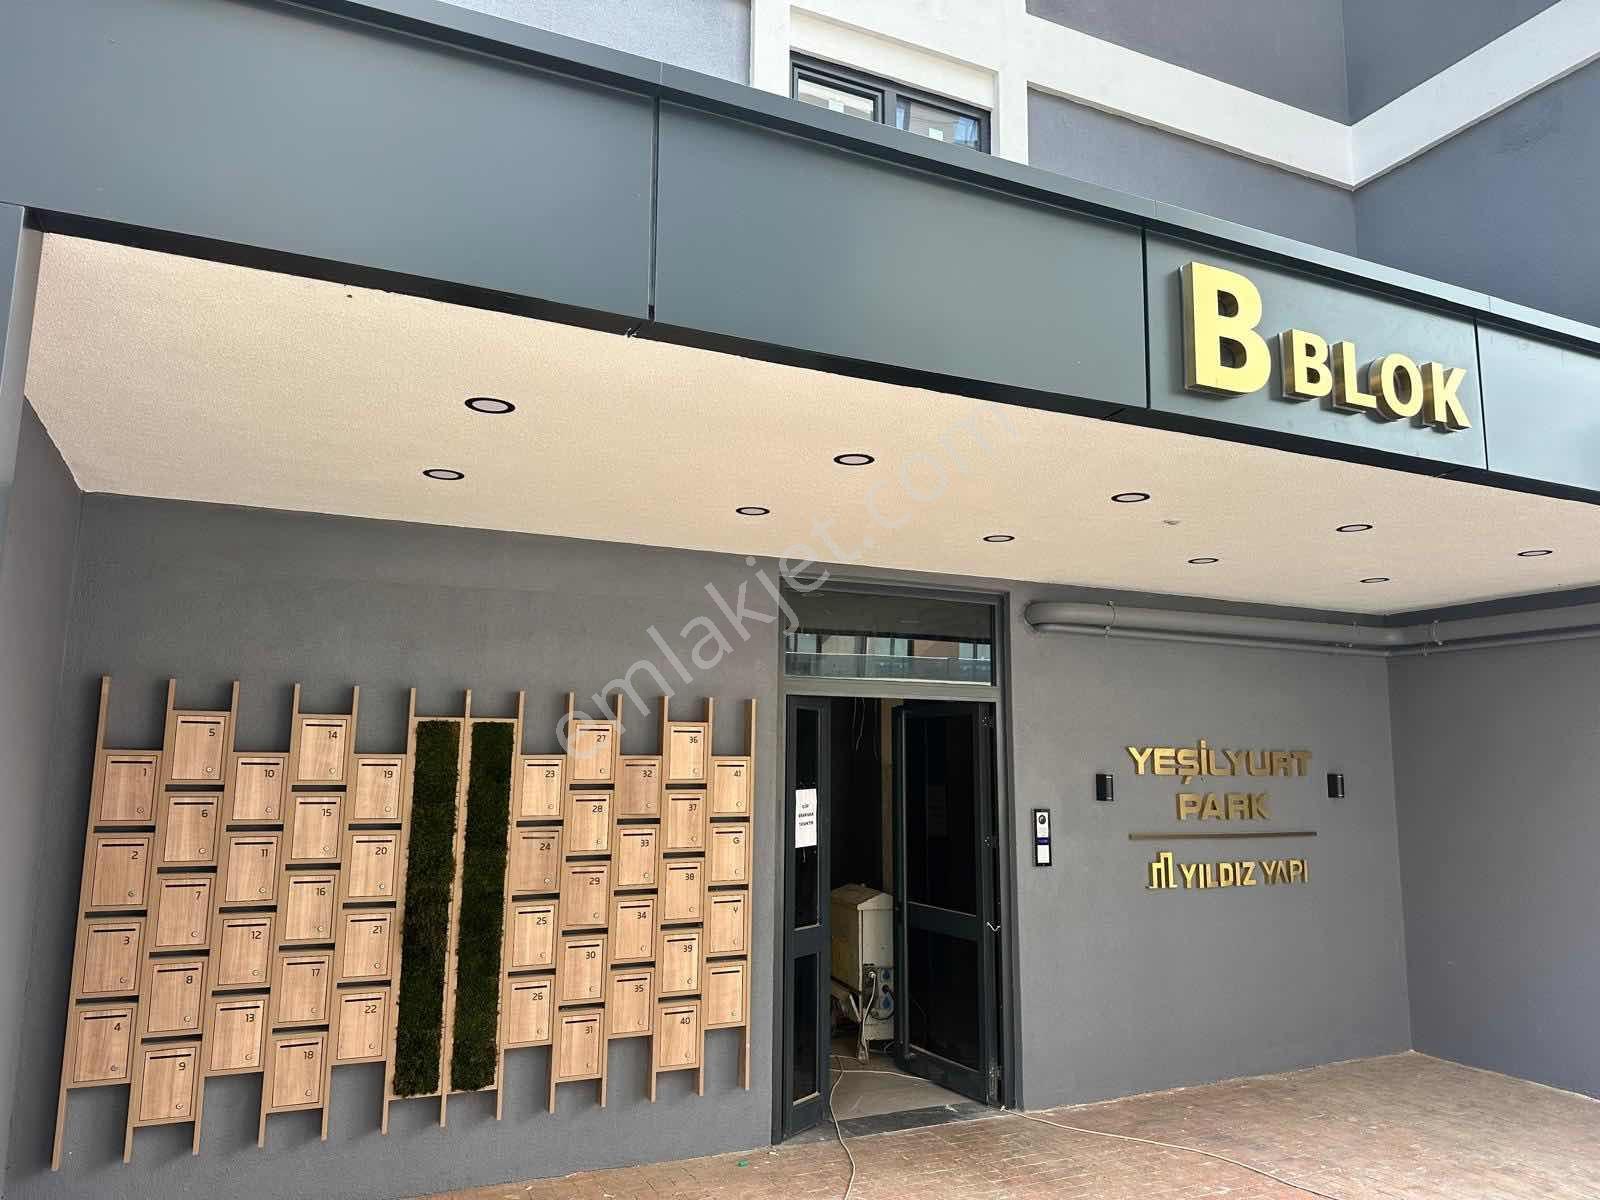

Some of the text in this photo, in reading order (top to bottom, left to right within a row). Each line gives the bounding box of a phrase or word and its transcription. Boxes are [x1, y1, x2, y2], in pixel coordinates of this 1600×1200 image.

[1180, 261, 1472, 430] B BLOK
[327, 730, 338, 739] 14
[596, 734, 606, 743] 27
[688, 735, 699, 745] 36
[1127, 739, 1312, 784] YEŞİLYURT
[263, 769, 275, 778] 10
[383, 768, 394, 779] 19
[544, 769, 555, 778] 23
[642, 769, 653, 778] 32
[591, 804, 604, 814] 28
[688, 803, 698, 812] 37
[1178, 792, 1268, 821] PARK
[321, 808, 332, 817] 15
[539, 842, 551, 851] 24
[640, 839, 650, 848] 33
[261, 848, 269, 858] 11
[375, 846, 388, 856] 20
[684, 872, 696, 881] 38
[1179, 860, 1309, 889] YILDIZ YAPI
[589, 876, 601, 886] 29
[316, 887, 326, 896] 16
[637, 911, 647, 920] 34
[536, 916, 548, 926] 25
[372, 925, 383, 934] 21
[251, 930, 262, 940] 12
[683, 944, 693, 953] 39
[585, 950, 596, 960] 30
[311, 968, 321, 977] 17
[634, 984, 644, 993] 35
[532, 991, 544, 1001] 26
[364, 1004, 377, 1014] 22
[245, 1013, 255, 1023] 13
[679, 1016, 691, 1026] 40
[584, 1025, 594, 1035] 31
[303, 1050, 314, 1060] 18
